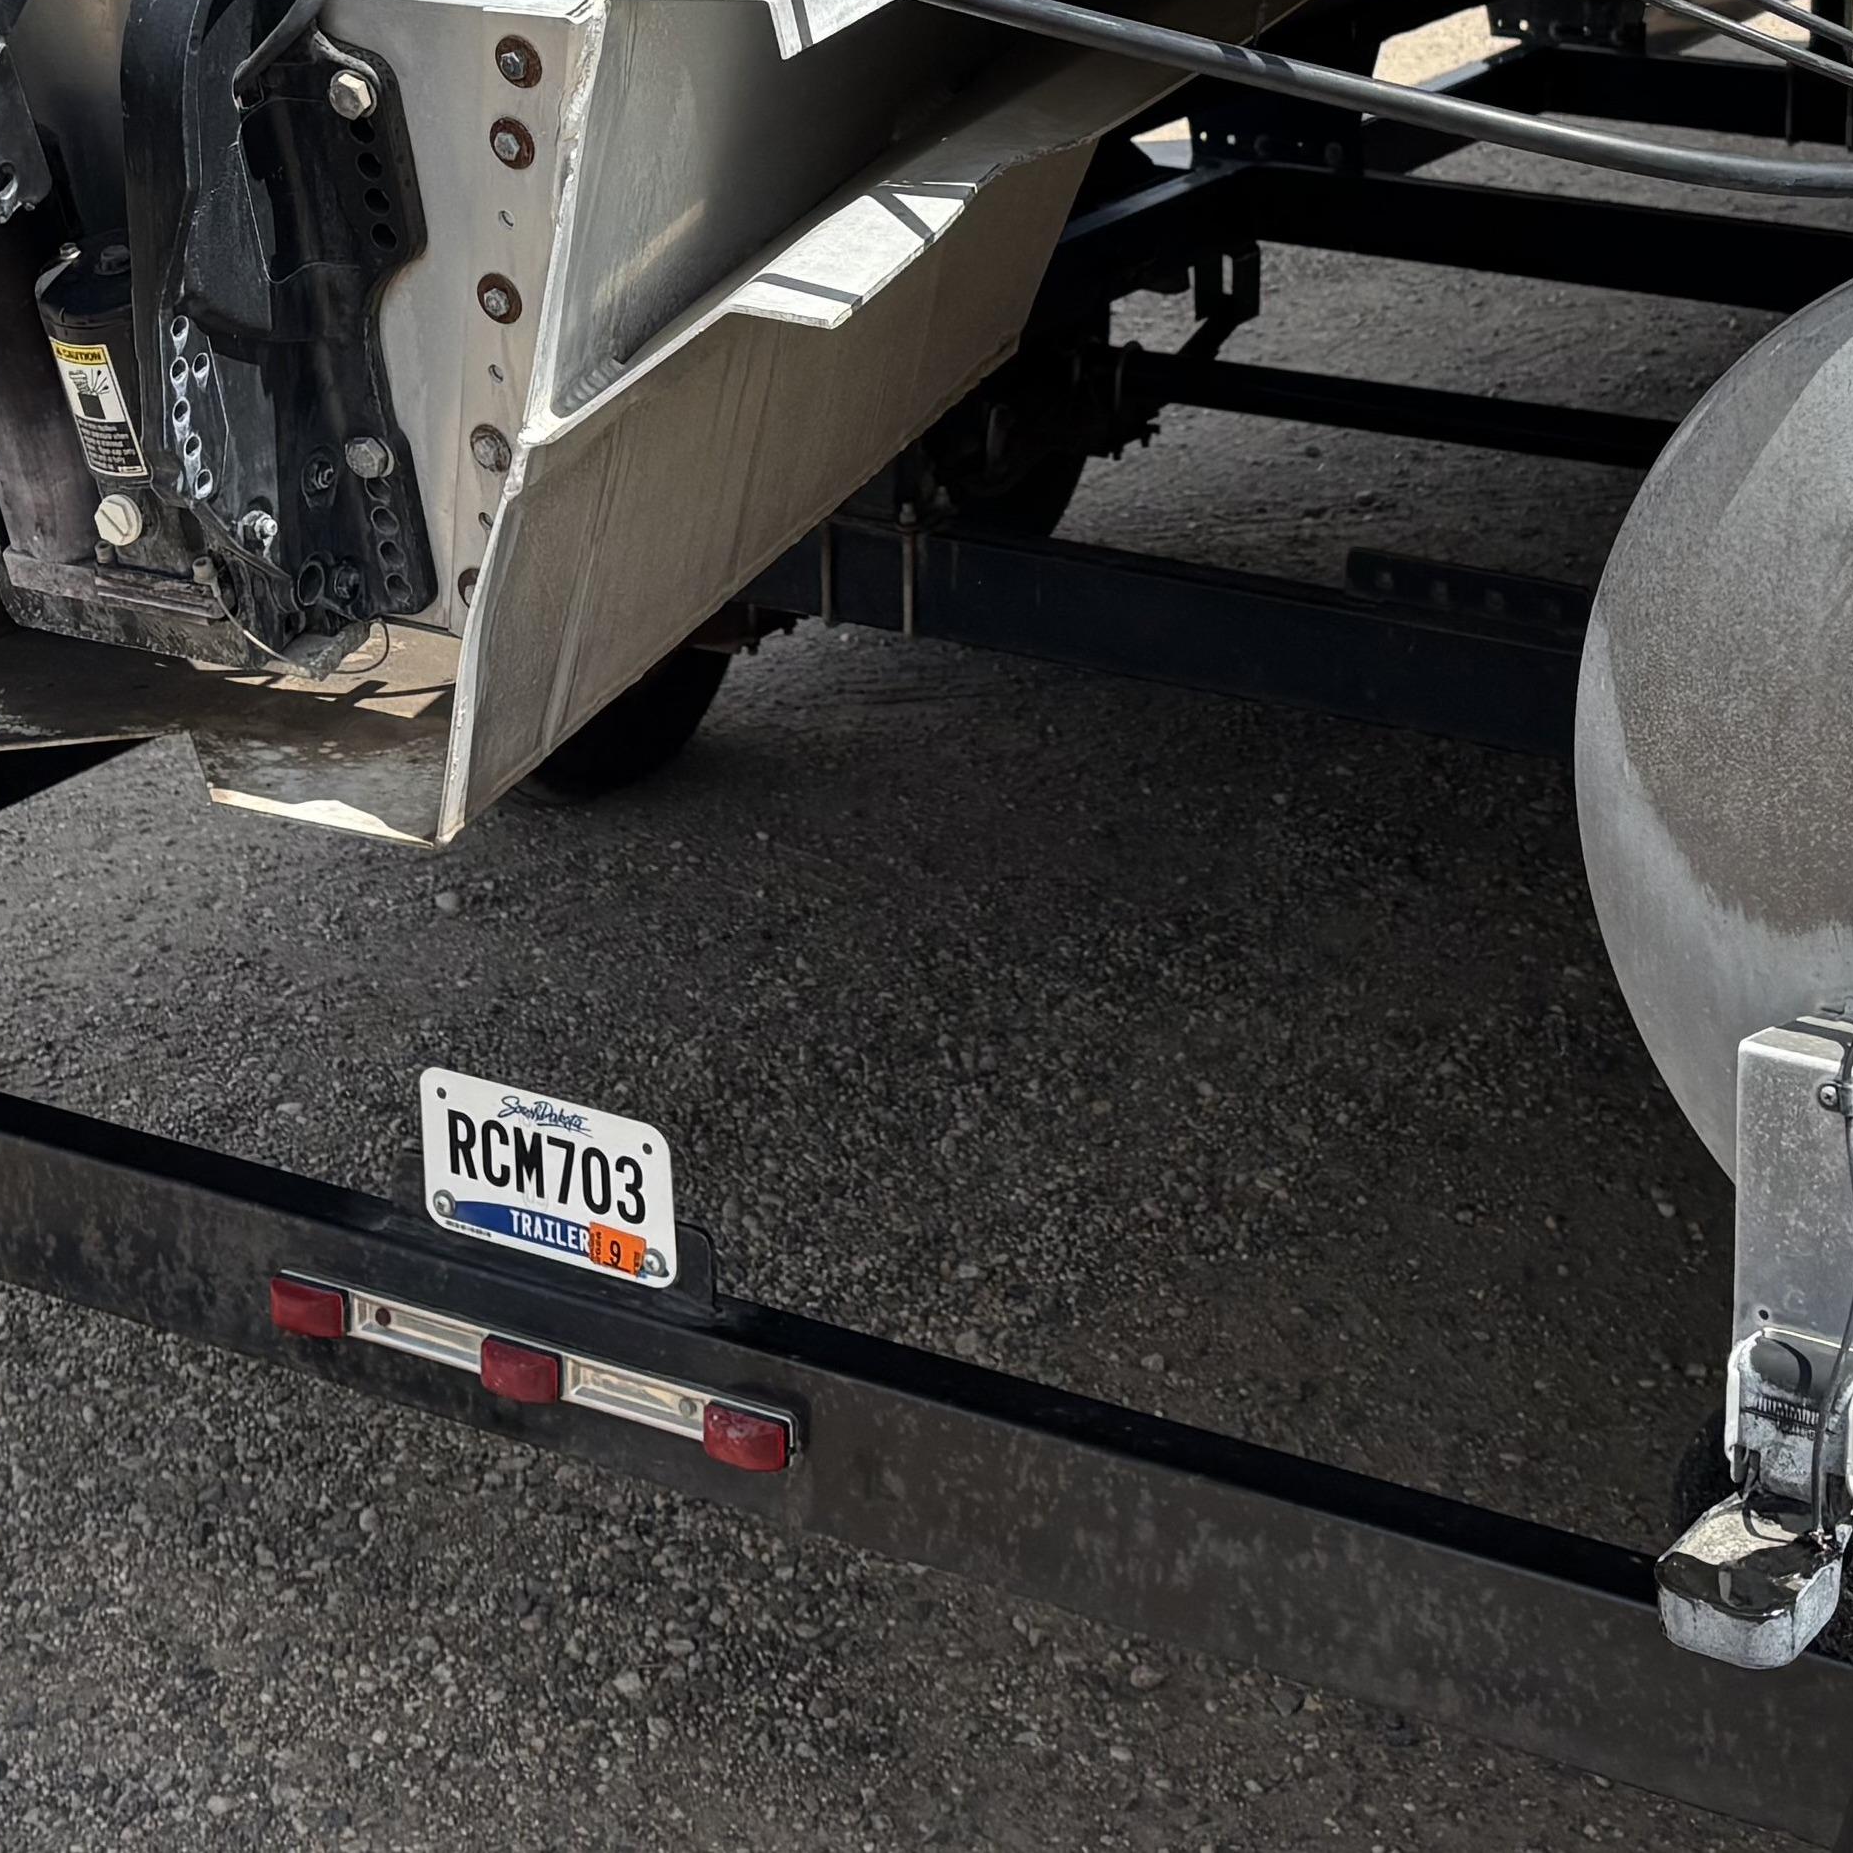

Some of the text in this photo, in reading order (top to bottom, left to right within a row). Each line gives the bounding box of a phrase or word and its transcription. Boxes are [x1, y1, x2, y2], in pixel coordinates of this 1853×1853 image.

[63, 348, 103, 362] CAUTION
[447, 1108, 646, 1225] RCM703
[509, 1208, 591, 1254] TRAILER
